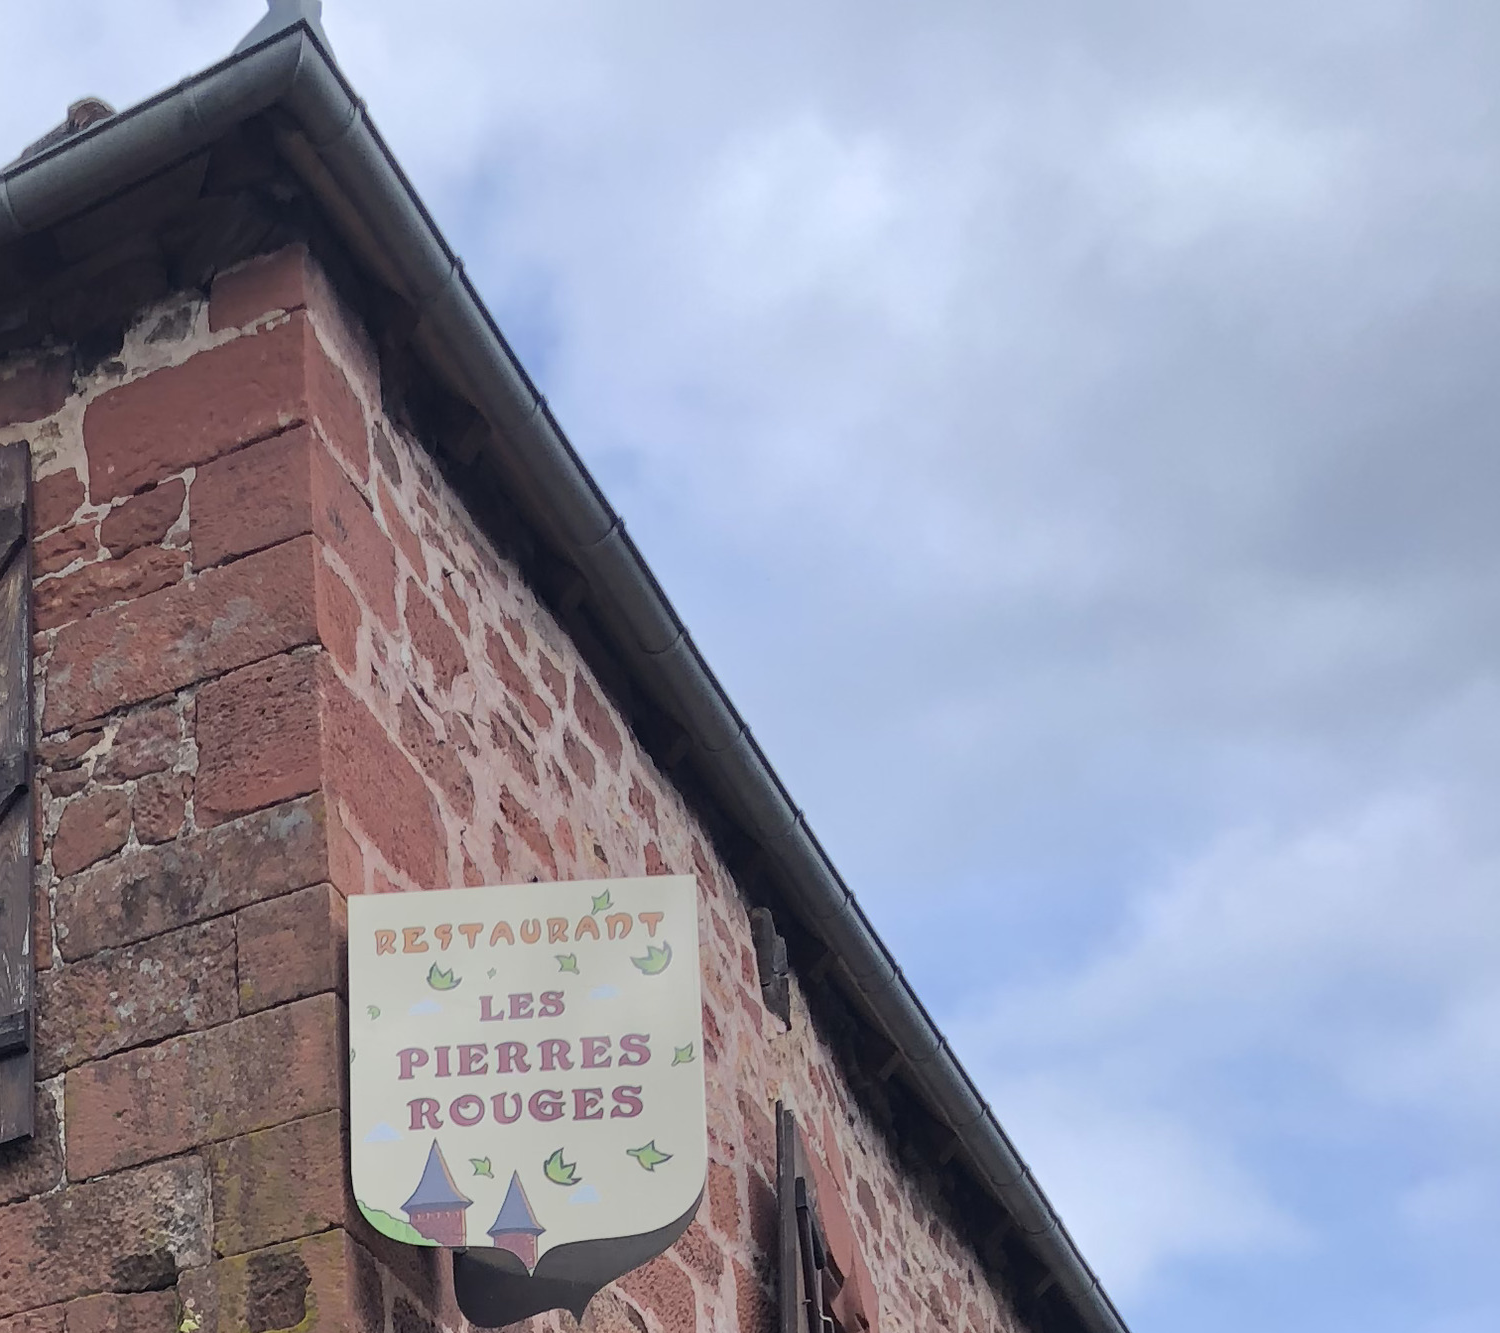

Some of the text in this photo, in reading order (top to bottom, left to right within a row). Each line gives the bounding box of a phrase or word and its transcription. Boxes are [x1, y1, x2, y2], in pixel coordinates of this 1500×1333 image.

[374, 912, 665, 956] RESTAURANT
[478, 991, 566, 1022] LES
[395, 1033, 652, 1080] PIERRES
[406, 1085, 645, 1131] ROUGES
